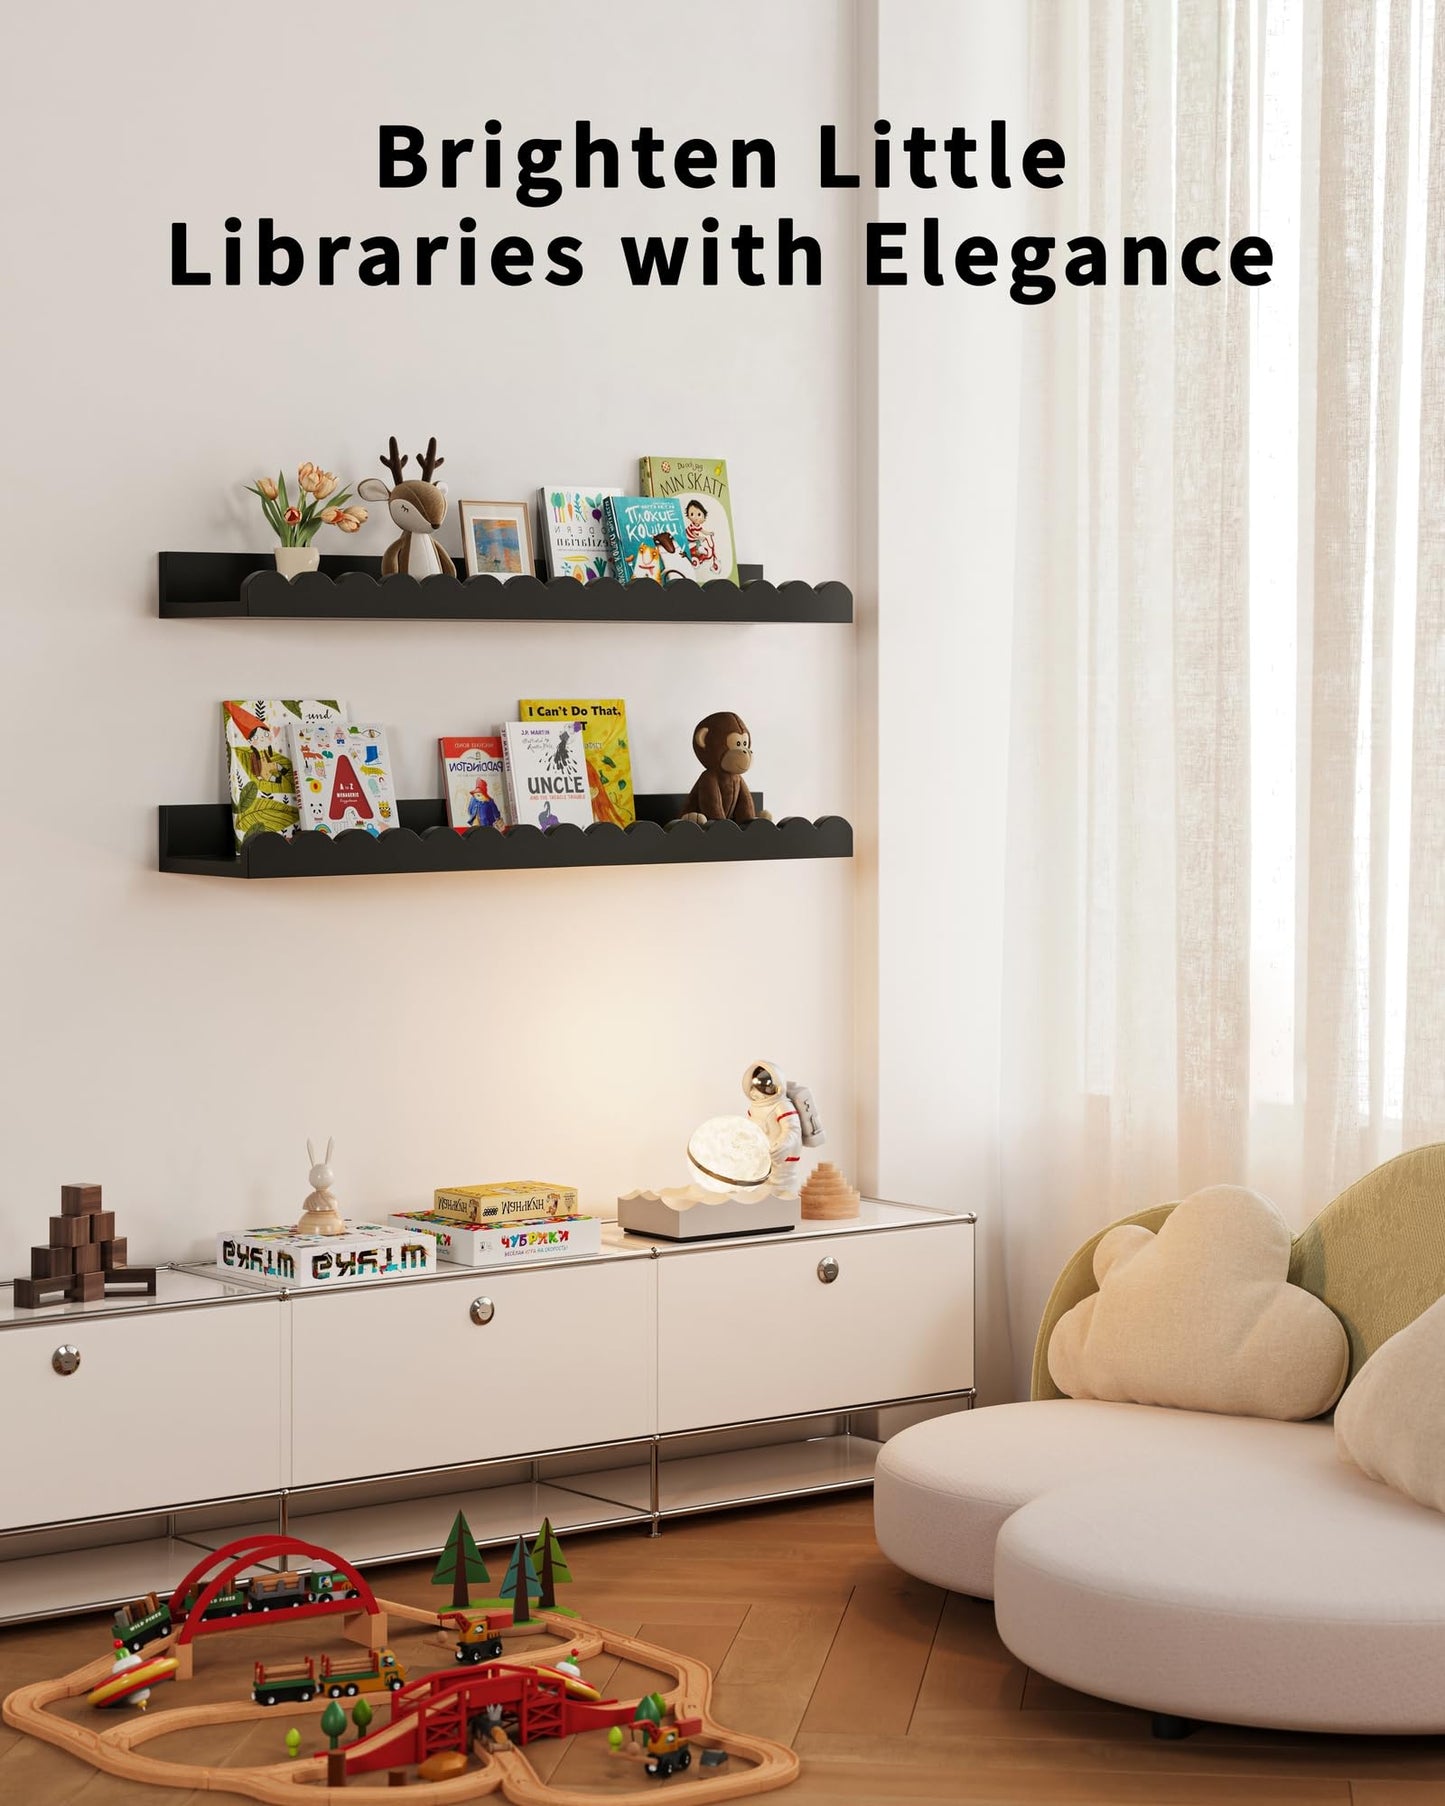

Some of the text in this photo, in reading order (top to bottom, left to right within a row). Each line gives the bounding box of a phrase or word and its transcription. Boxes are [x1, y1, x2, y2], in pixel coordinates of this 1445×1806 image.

[660, 472, 727, 498] MIN SKATT
[306, 709, 332, 720] und
[529, 706, 621, 717] I Can't Do That,
[527, 776, 585, 795] UNCLE
[501, 1229, 569, 1248] ЧУБРИКИ
[130, 1621, 145, 1632] WILD
